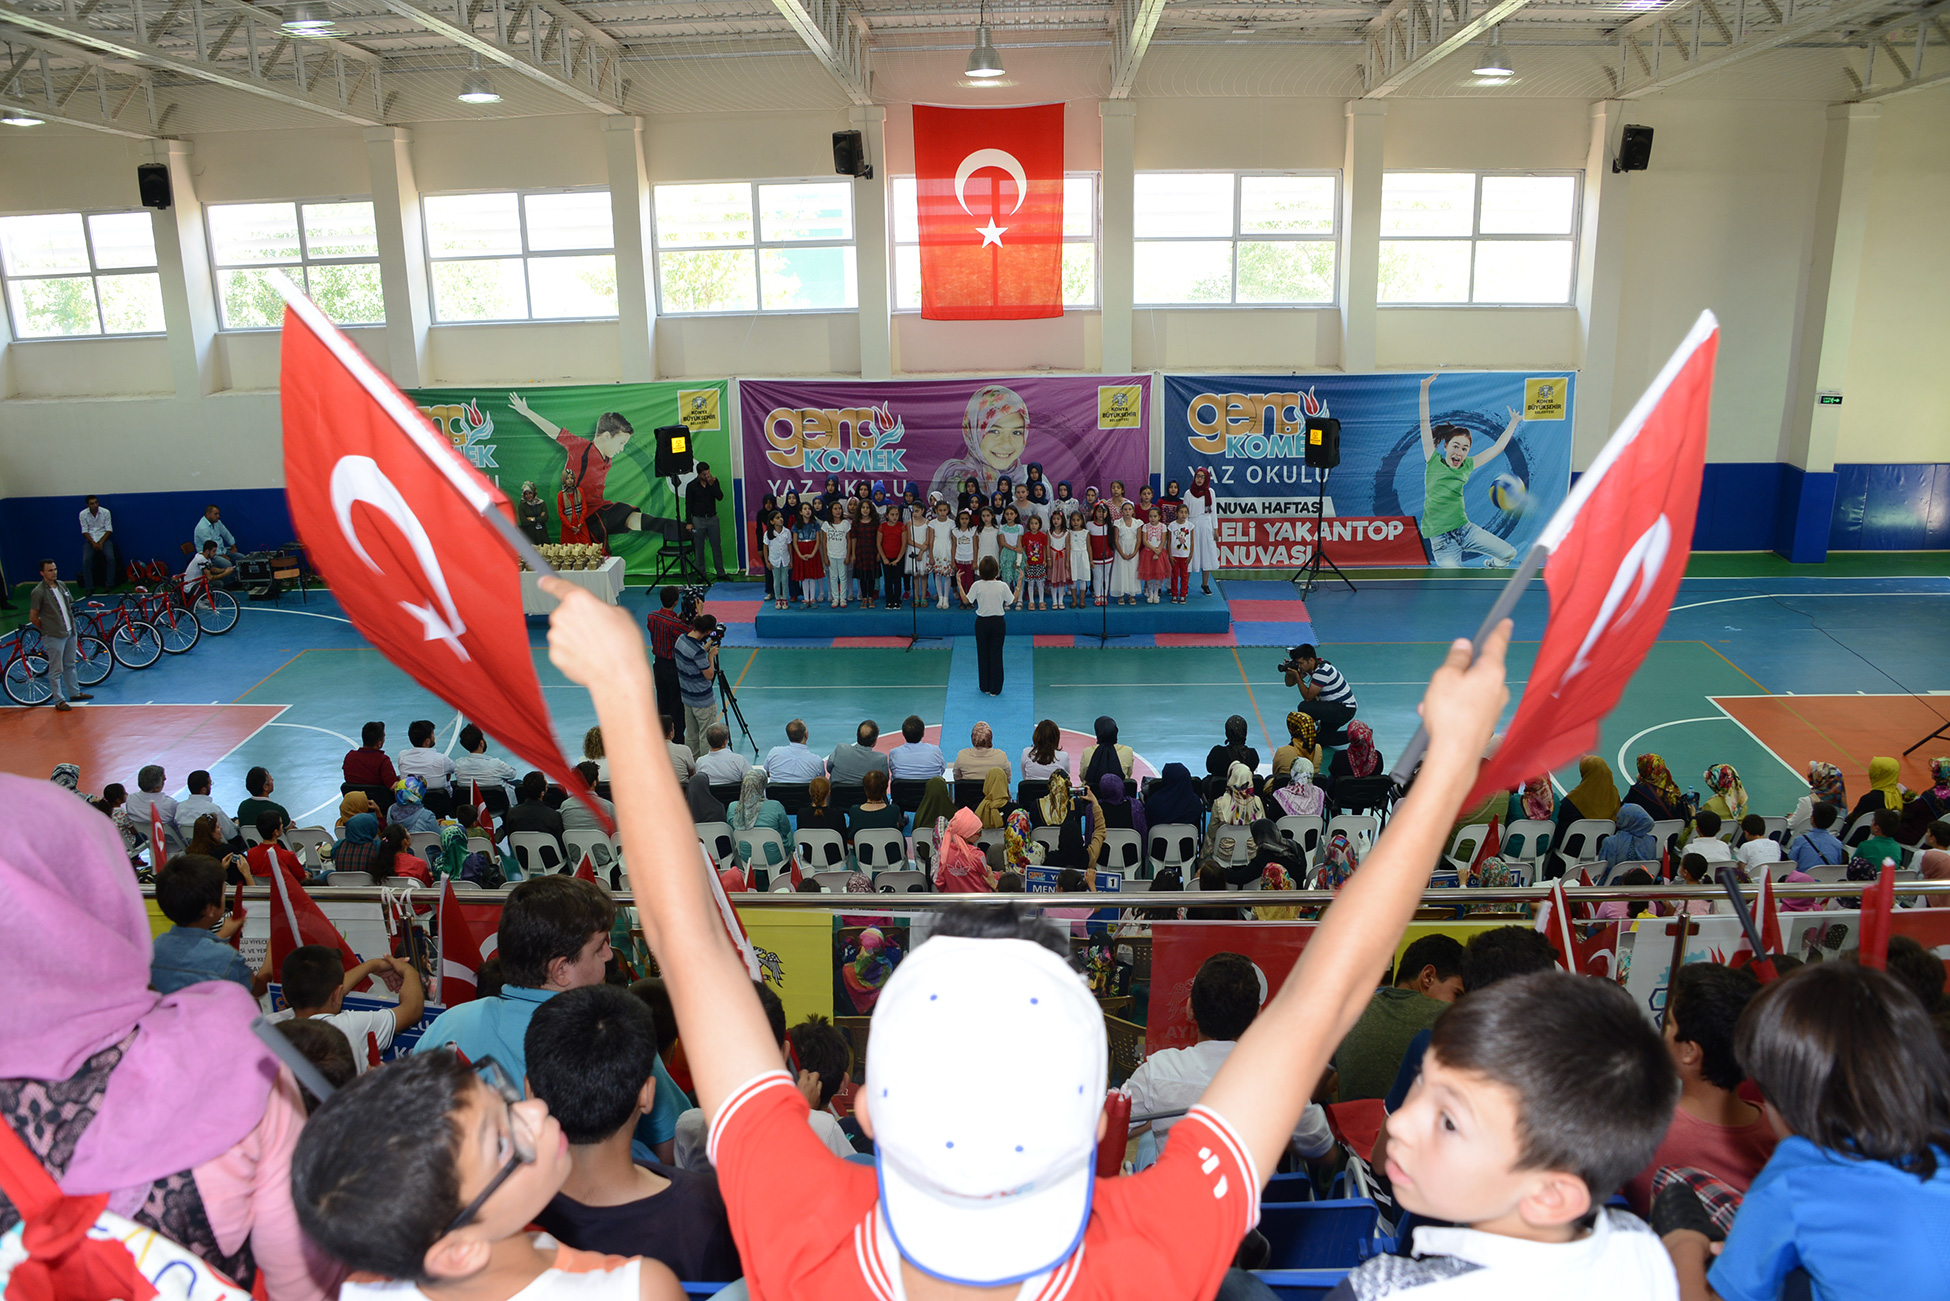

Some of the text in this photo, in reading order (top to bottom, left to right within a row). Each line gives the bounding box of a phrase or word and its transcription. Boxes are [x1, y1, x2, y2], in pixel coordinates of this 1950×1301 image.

[1225, 434, 1306, 459] KOME
[804, 448, 908, 473] KOMEK
[1246, 465, 1330, 484] OKULU
[1216, 502, 1258, 514] NUVA
[1263, 520, 1404, 543] YAKANTOP
[1217, 545, 1312, 566] NUVASI
[1032, 884, 1056, 893] MEN
